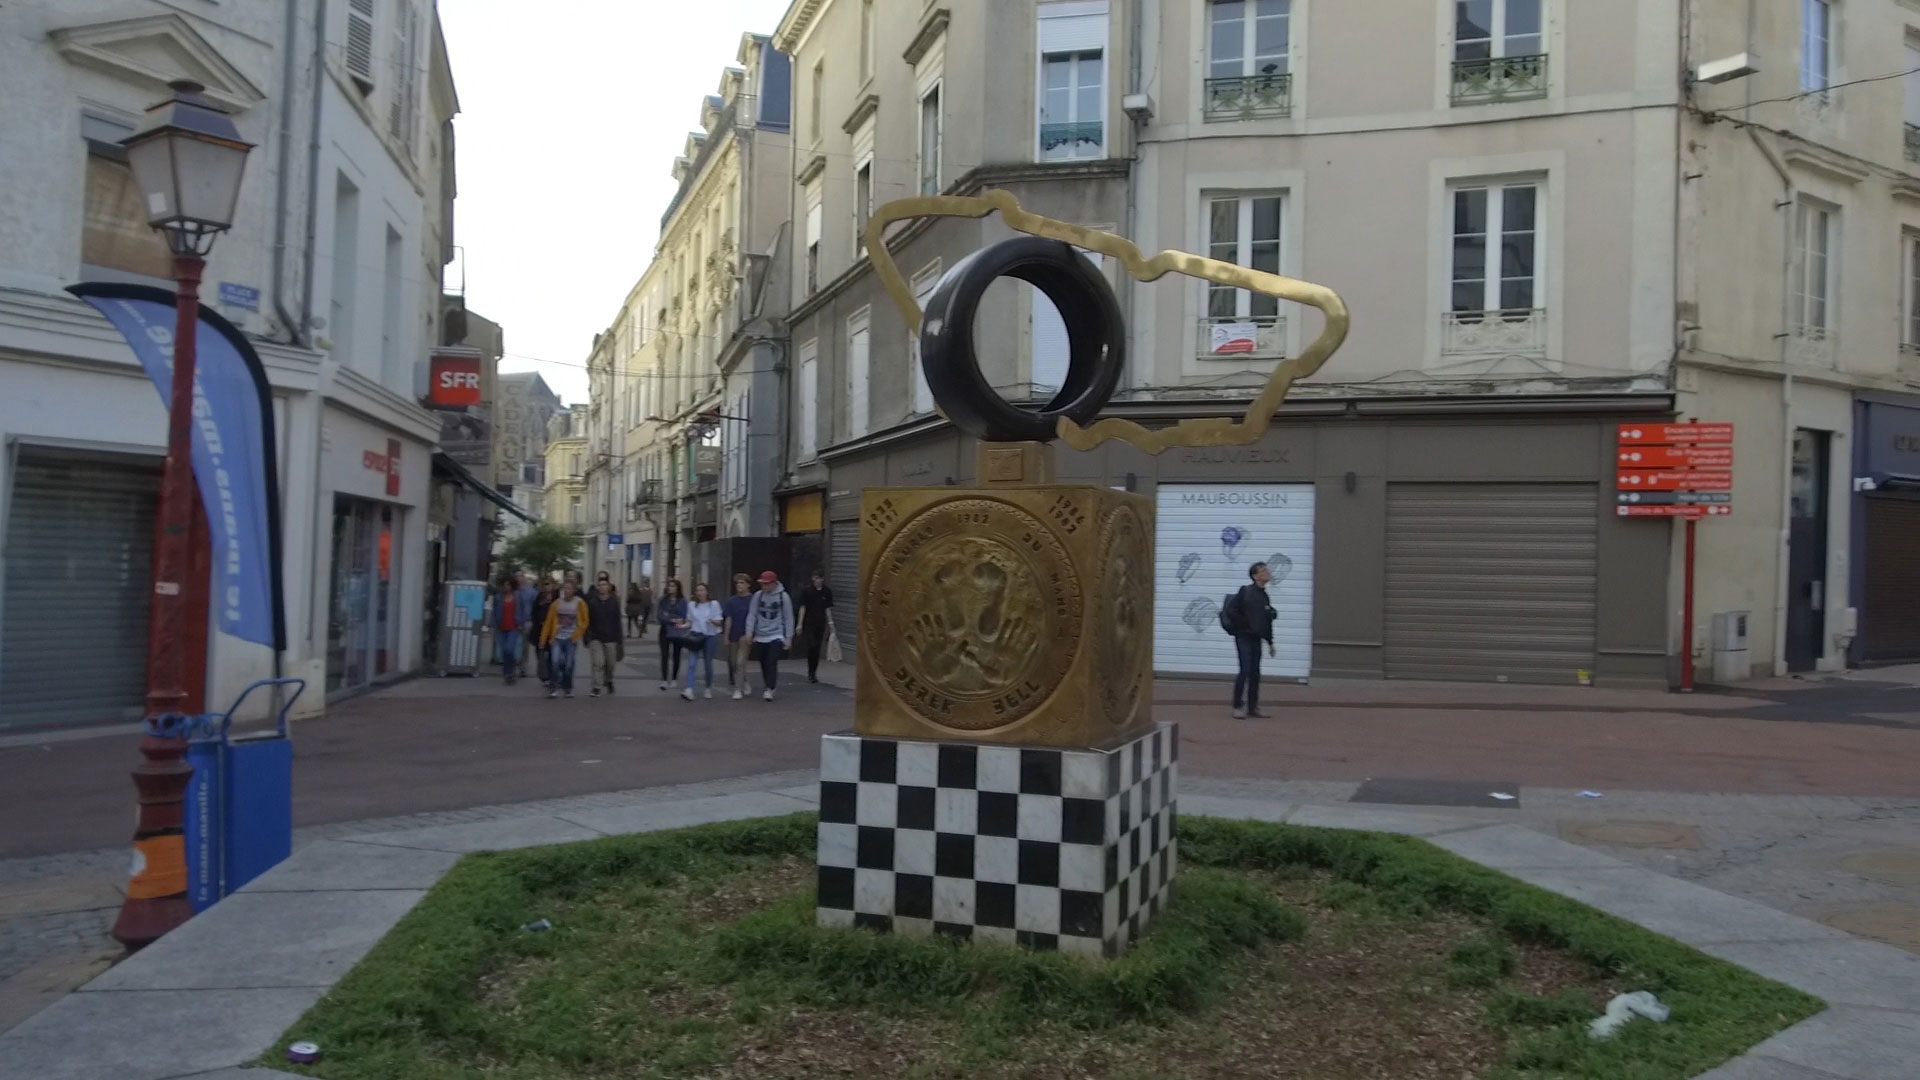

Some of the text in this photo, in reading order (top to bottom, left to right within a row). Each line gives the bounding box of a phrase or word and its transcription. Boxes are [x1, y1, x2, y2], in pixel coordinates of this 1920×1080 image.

[439, 371, 480, 389] SFR
[503, 384, 520, 473] CADEAUX
[1181, 491, 1289, 506] MAUBOUSSIN
[894, 668, 1042, 715] DEREK BELL
